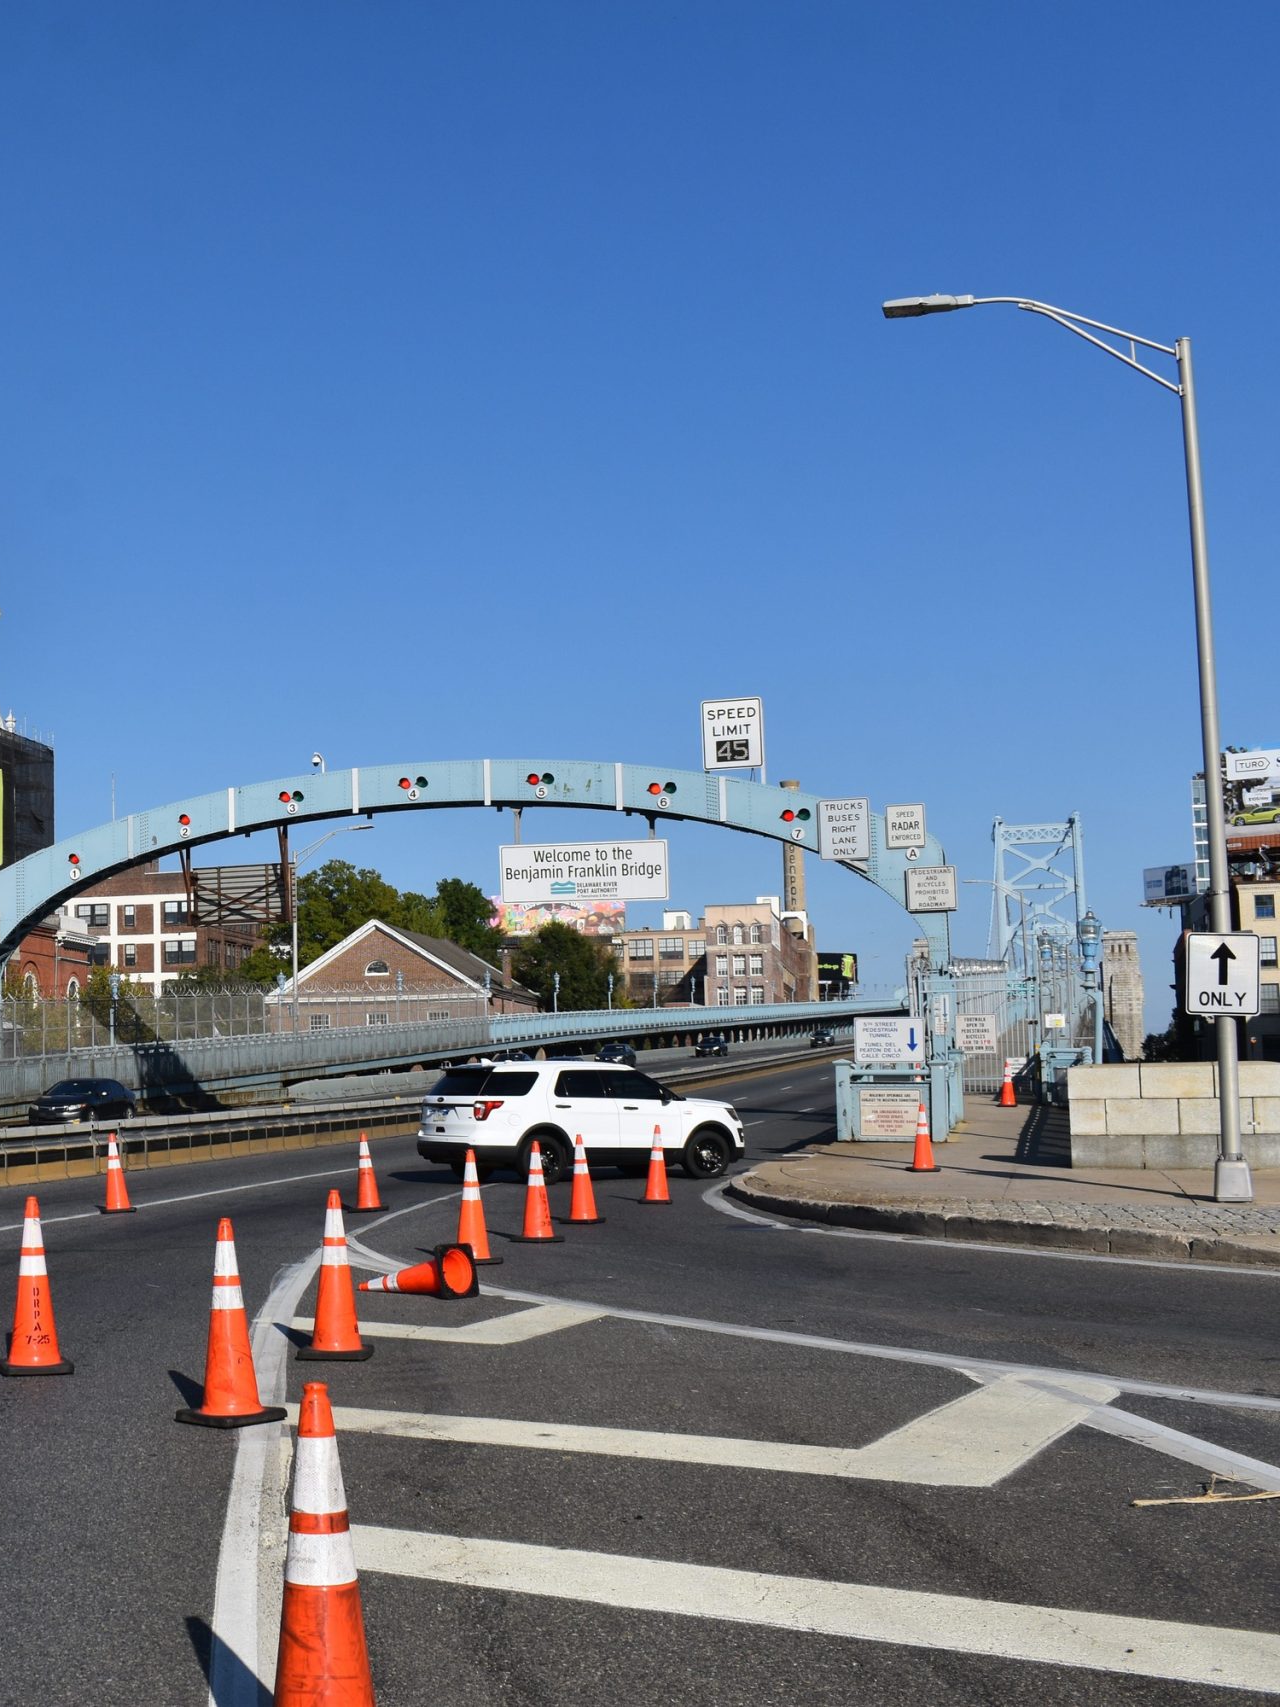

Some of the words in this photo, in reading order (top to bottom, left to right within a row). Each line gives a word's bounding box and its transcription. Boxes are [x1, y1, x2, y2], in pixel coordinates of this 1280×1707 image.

[707, 706, 756, 720] SPEED
[713, 724, 751, 737] LIMIT
[717, 740, 748, 760] 45
[1239, 761, 1264, 769] TURO
[409, 790, 416, 798] 4
[539, 787, 545, 796] 5
[660, 798, 667, 806] 6
[825, 802, 863, 811] TRUCKS
[289, 804, 296, 813] 3
[828, 814, 860, 822] BUSES
[832, 825, 856, 833] RIGHT
[891, 821, 920, 831] RADAR
[181, 827, 188, 836] 2
[795, 830, 801, 838] 7
[832, 836, 857, 844] LANE
[533, 850, 590, 863] Welcome
[596, 849, 608, 861] to
[613, 847, 632, 860] the
[833, 848, 857, 856] ONLY
[909, 849, 917, 858] A
[506, 866, 563, 882] Benjamin
[568, 864, 617, 878] Franklin
[622, 862, 662, 879] Bridge
[910, 868, 952, 876] PEDESTRIANS
[1199, 991, 1247, 1007] ONLY
[32, 1287, 42, 1332] DRPA
